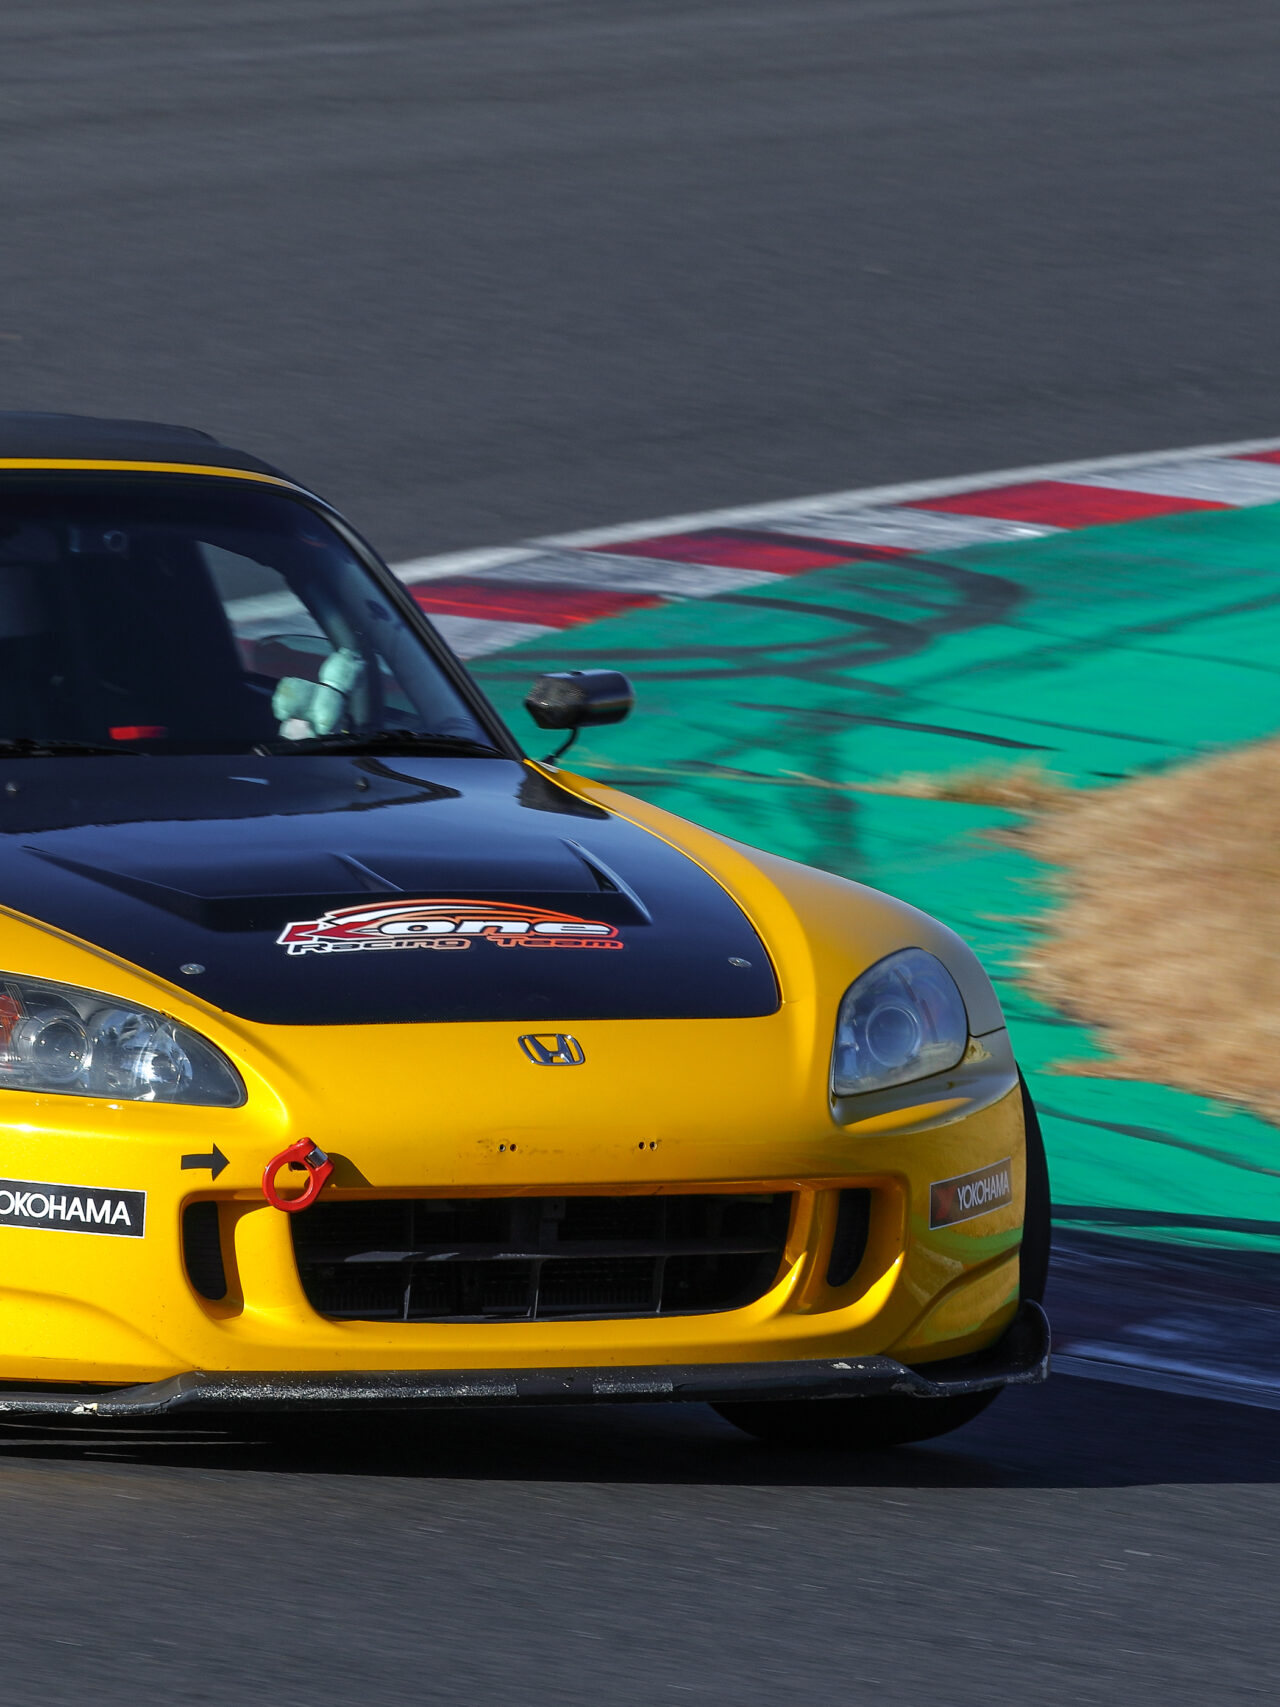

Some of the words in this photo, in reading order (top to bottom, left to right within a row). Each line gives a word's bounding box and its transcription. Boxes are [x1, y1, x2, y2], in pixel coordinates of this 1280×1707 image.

[287, 940, 471, 955] Racing
[487, 936, 625, 949] Team
[957, 1170, 1010, 1211] YOKOHAMA
